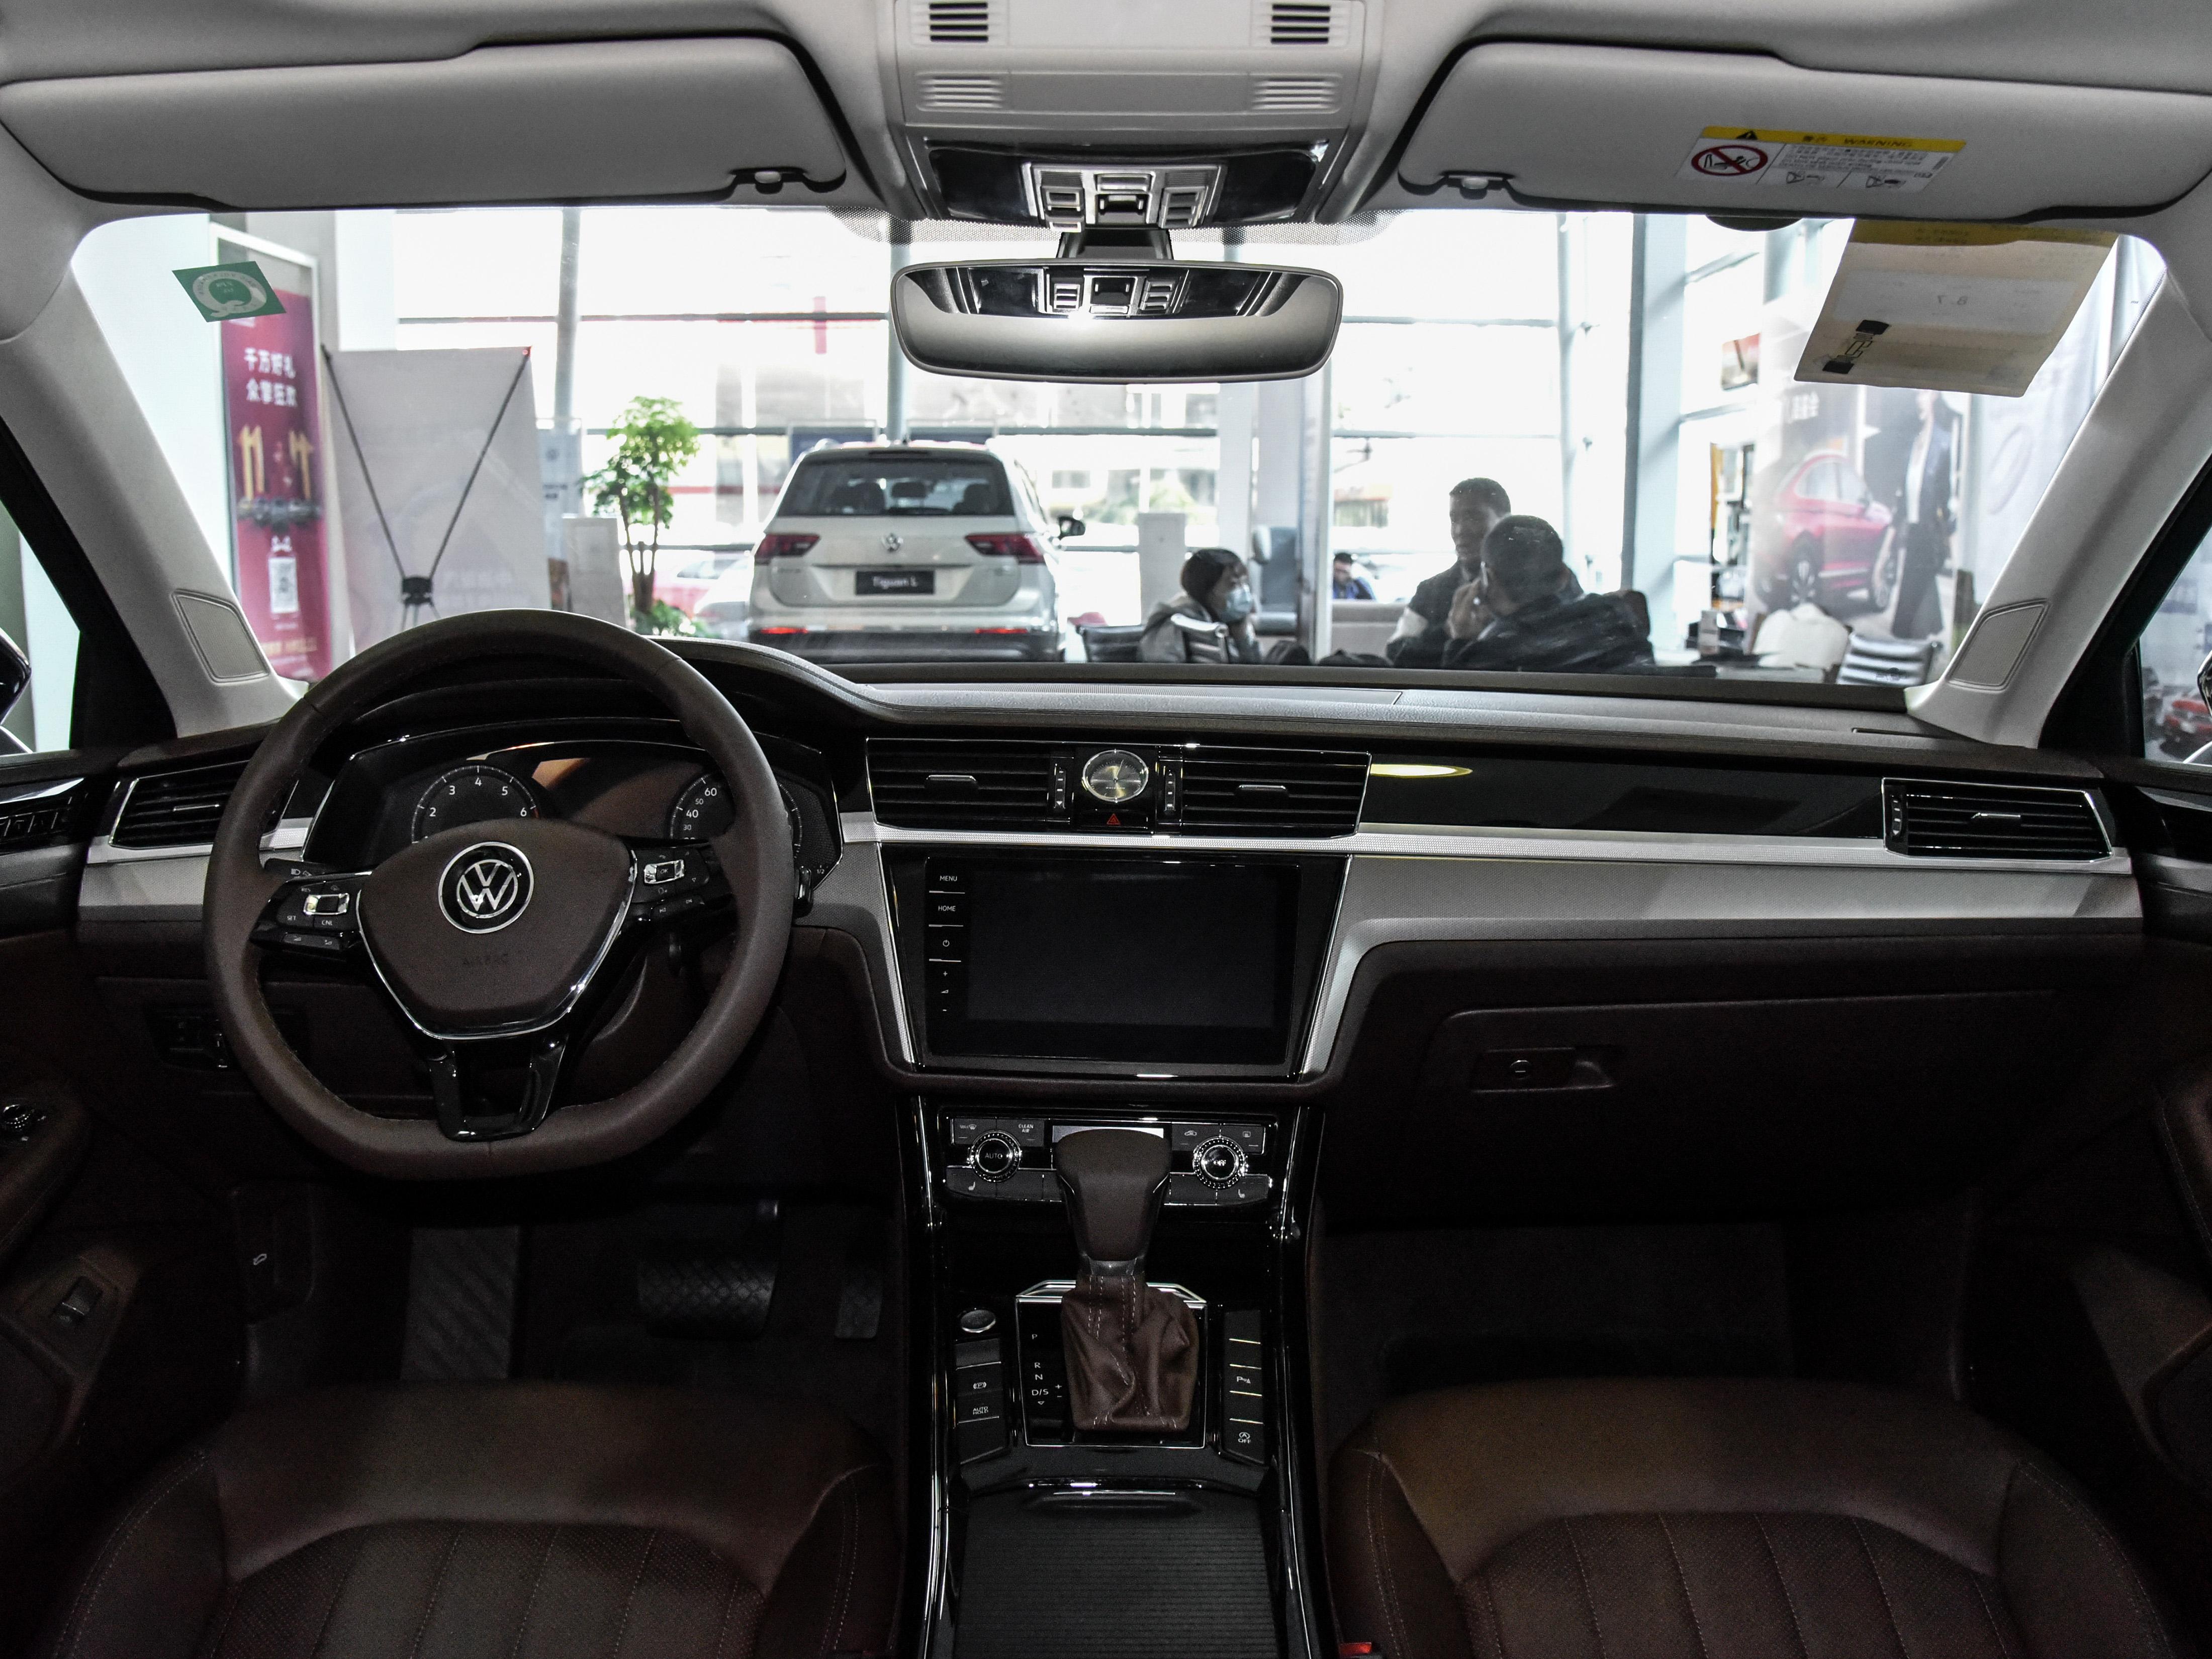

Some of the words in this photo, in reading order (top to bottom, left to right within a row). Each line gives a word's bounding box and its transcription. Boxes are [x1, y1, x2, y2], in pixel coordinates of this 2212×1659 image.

[475, 777, 482, 786] 4
[449, 785, 455, 795] 3
[502, 786, 508, 795] 5
[704, 788, 717, 796] 60
[429, 807, 436, 816] 2
[520, 807, 527, 816] 6
[686, 809, 699, 818] 40
